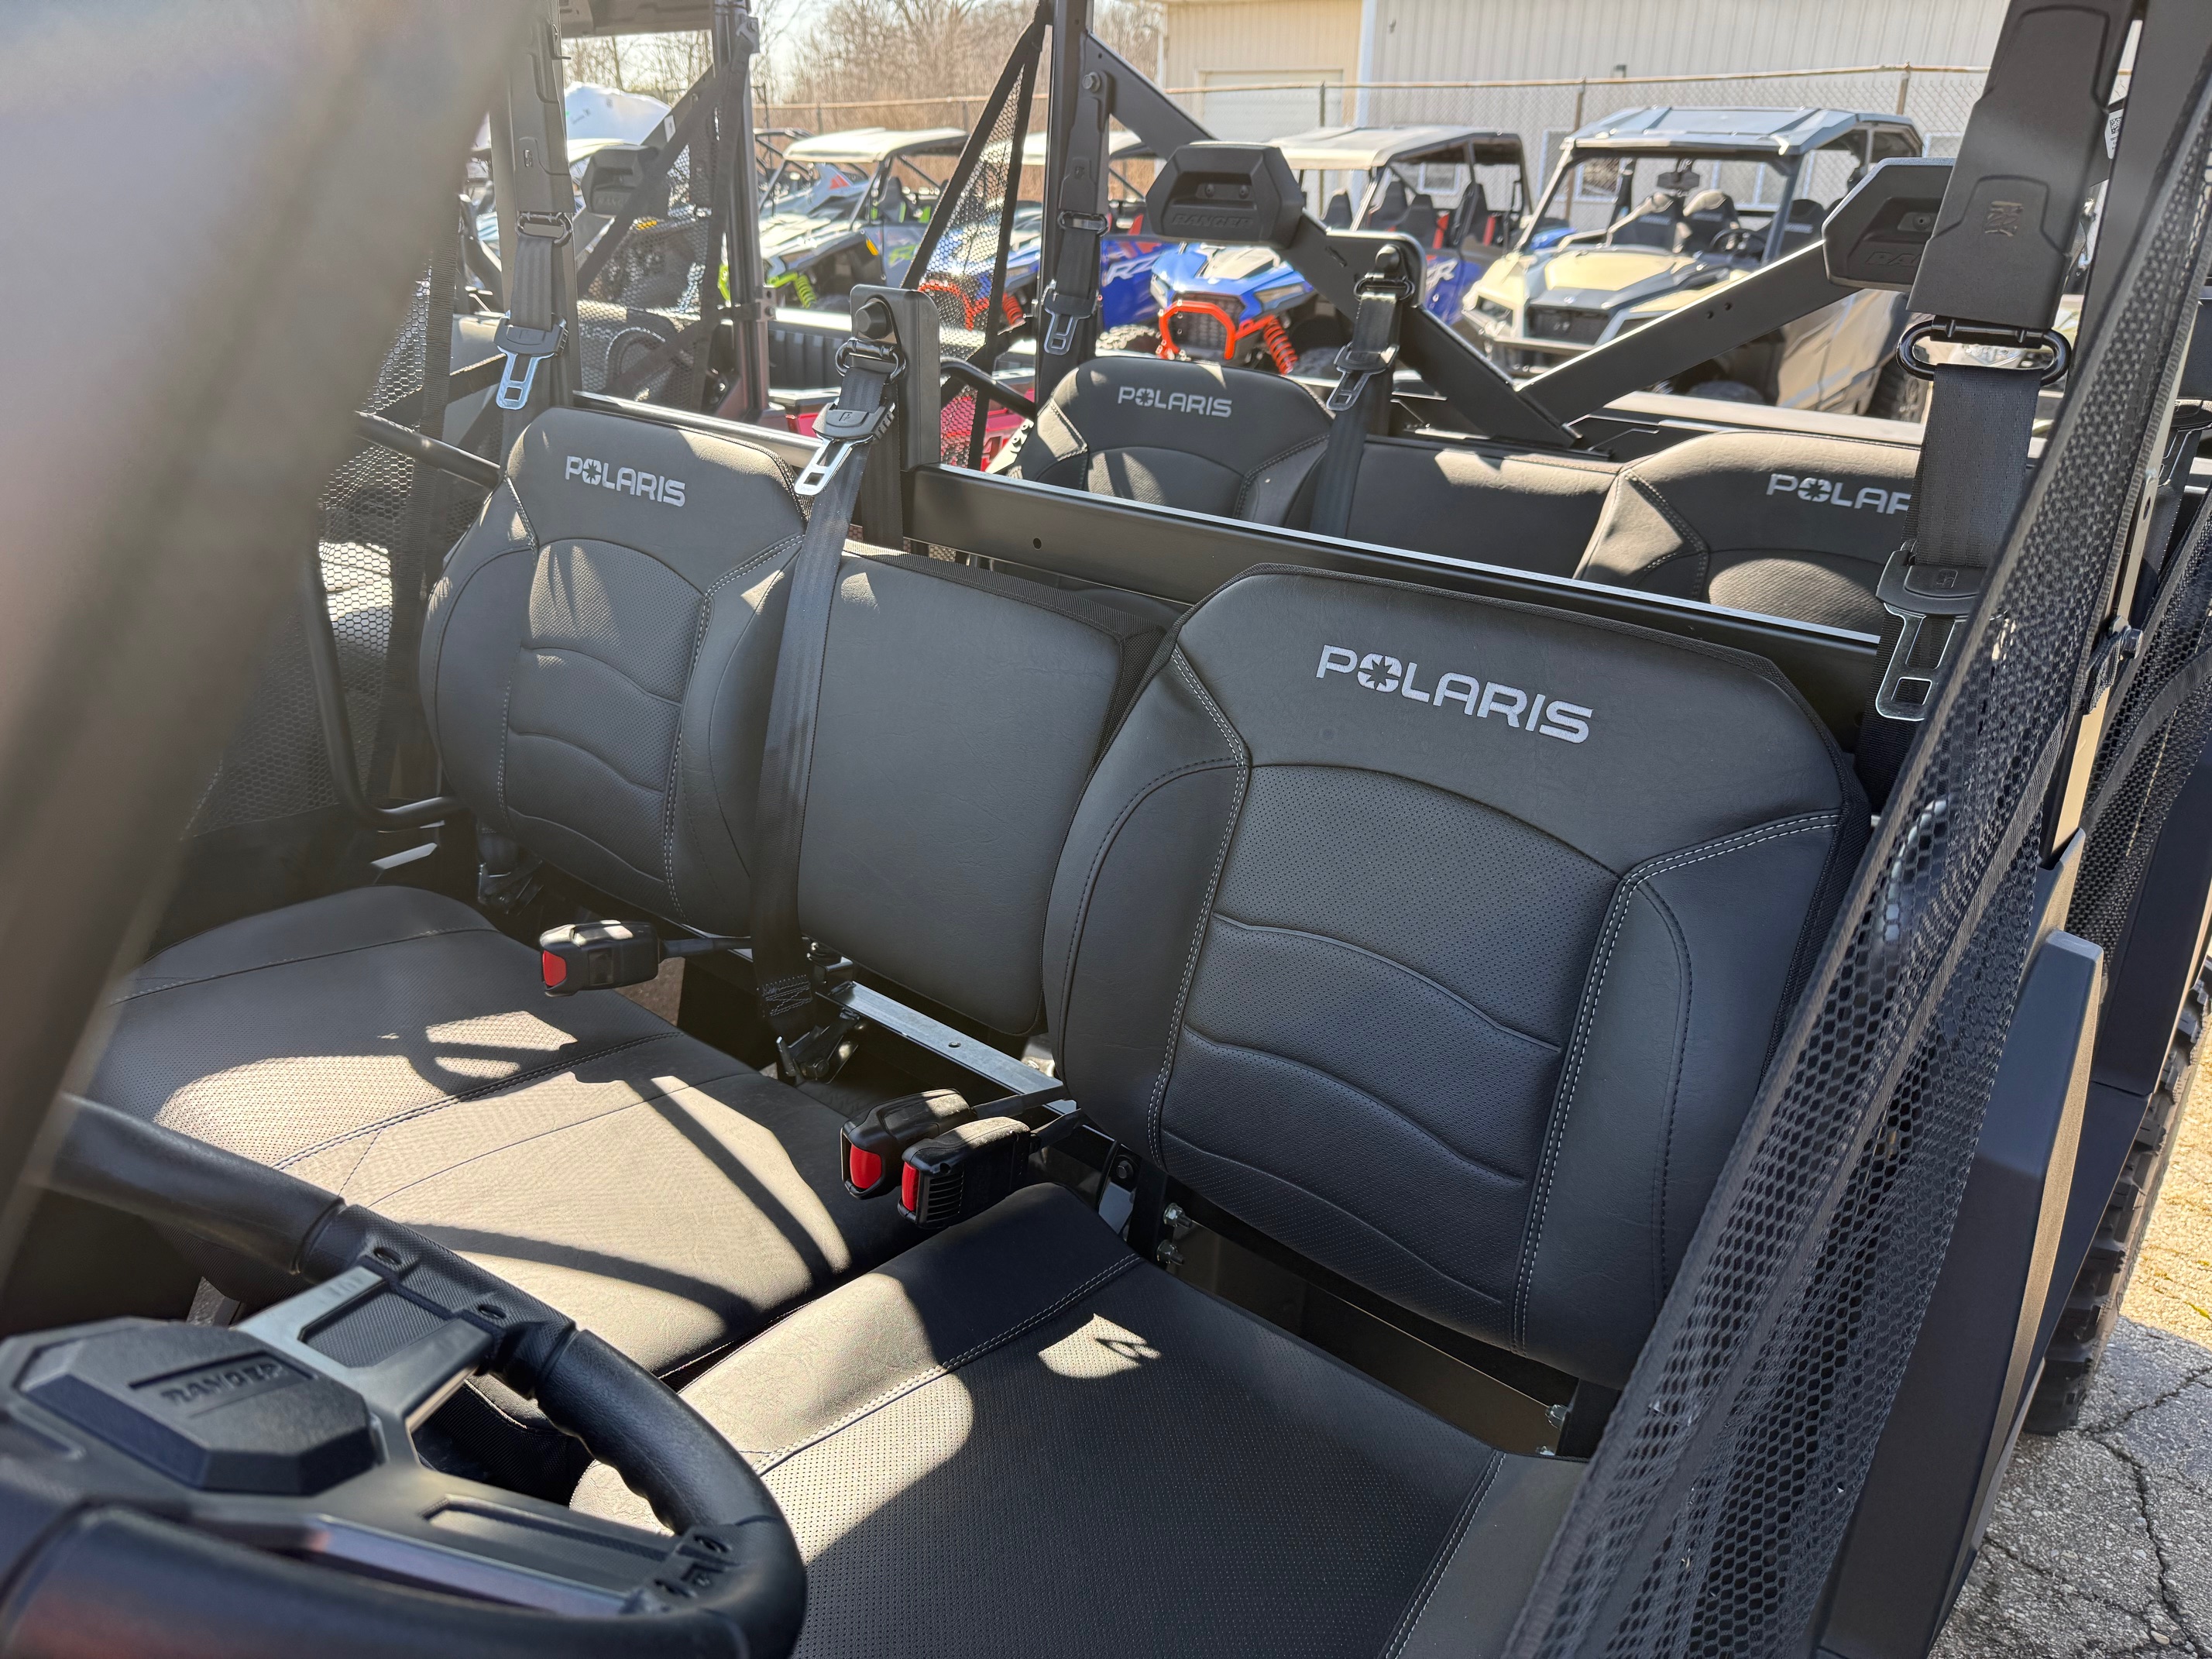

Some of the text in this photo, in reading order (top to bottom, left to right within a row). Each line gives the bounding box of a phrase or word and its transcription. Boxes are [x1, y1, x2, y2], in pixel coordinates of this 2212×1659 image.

[1171, 213, 1253, 229] RANGER
[1117, 386, 1233, 418] POLARIS
[565, 455, 685, 507] POLARIS
[1765, 472, 1912, 514] POLAR
[1316, 644, 1593, 744] POLARIS
